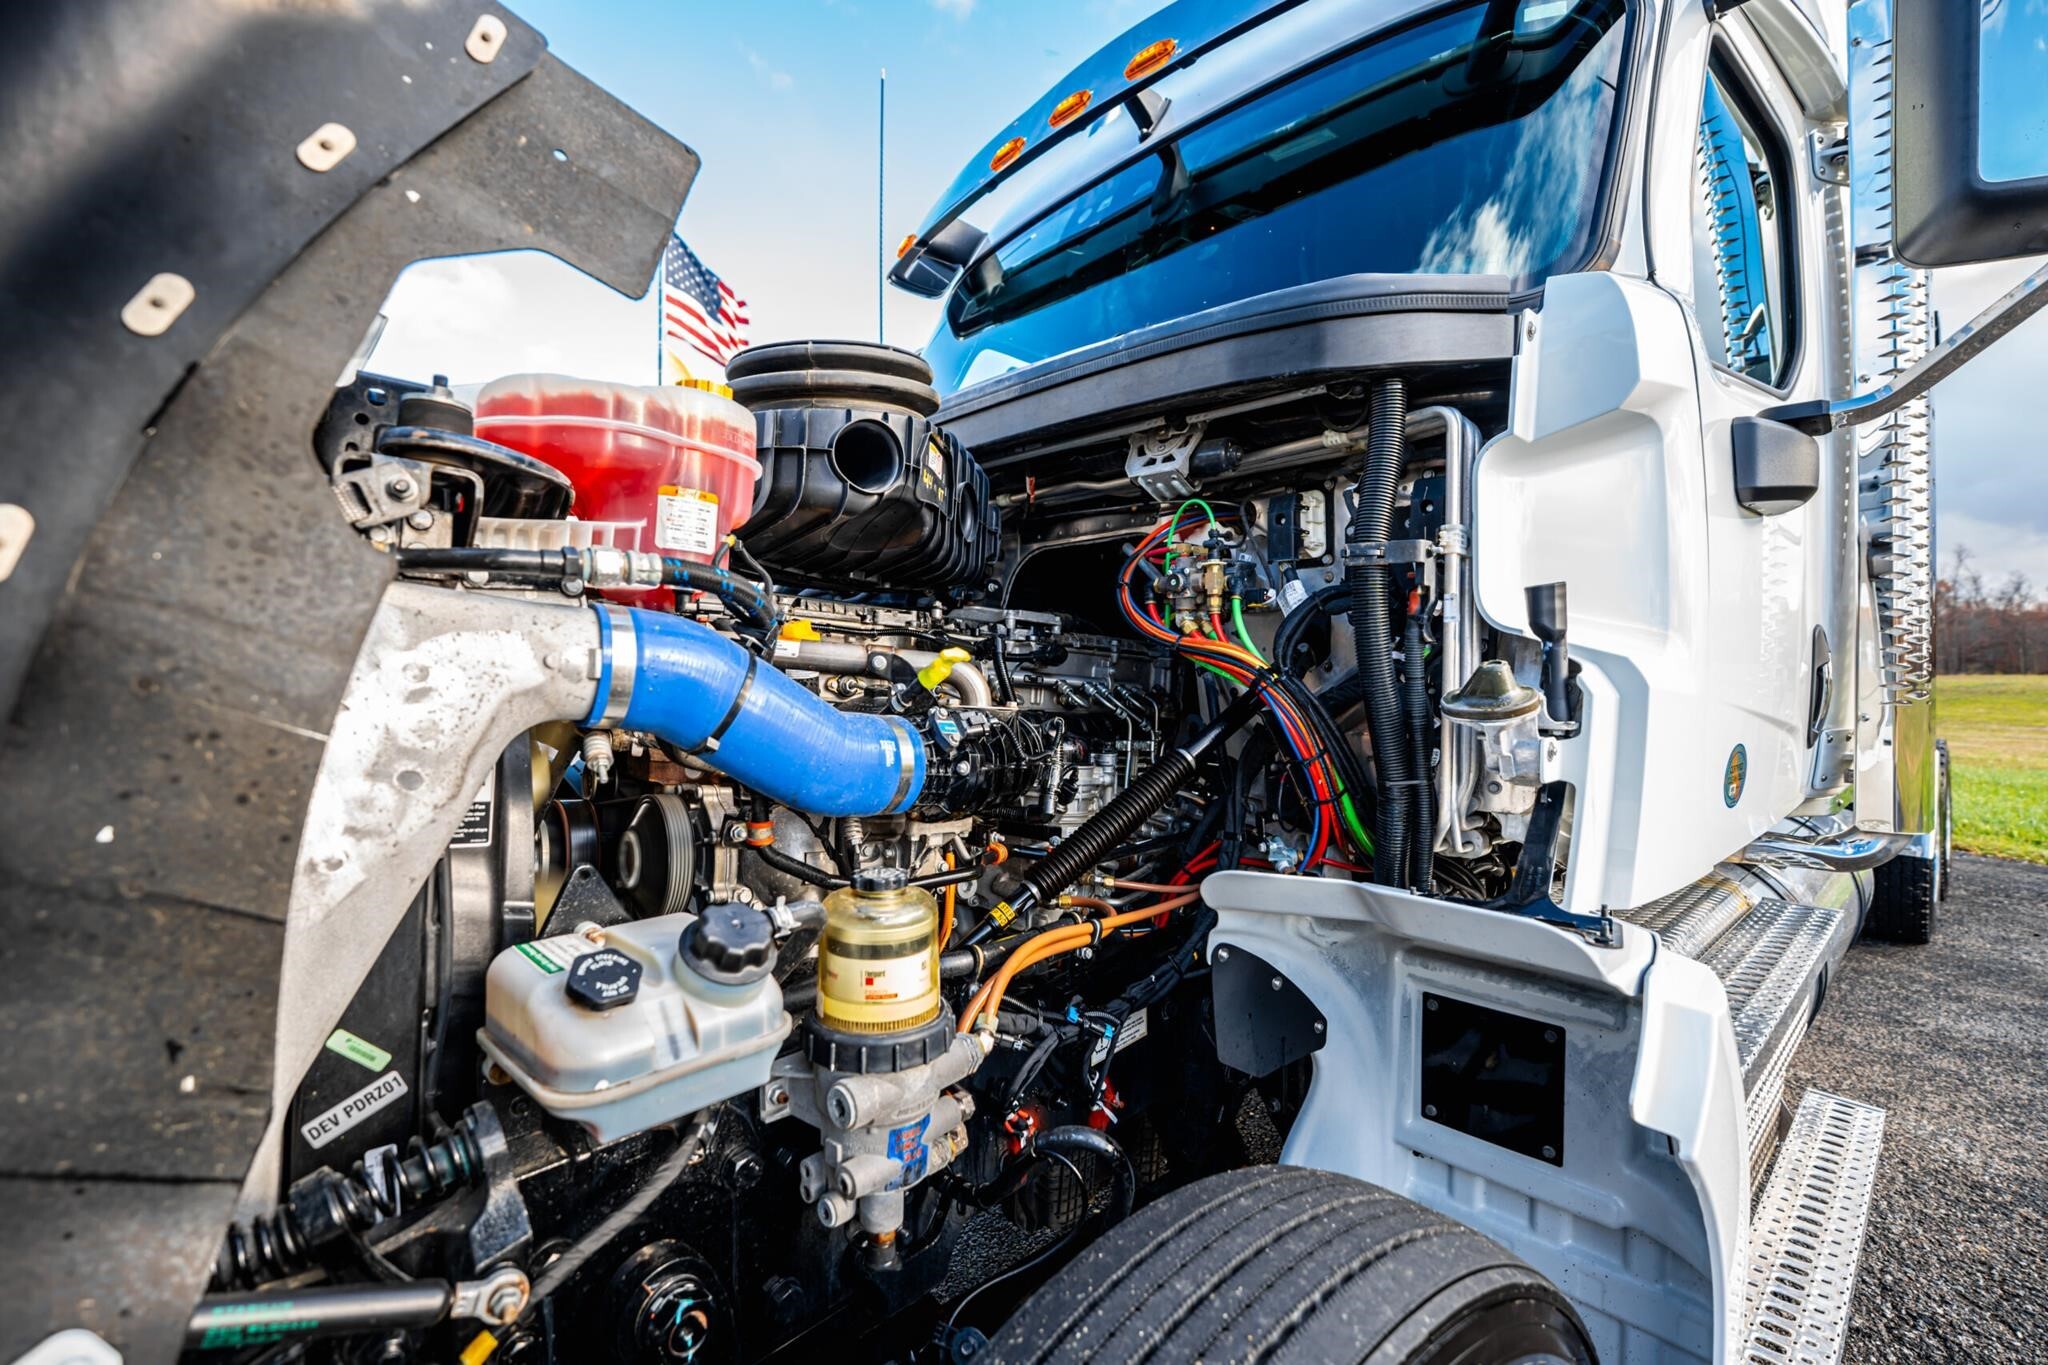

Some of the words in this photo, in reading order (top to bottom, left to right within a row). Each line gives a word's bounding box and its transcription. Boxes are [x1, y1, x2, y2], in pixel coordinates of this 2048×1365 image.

[577, 957, 594, 976] POWER
[594, 954, 629, 966] STEERING
[590, 960, 614, 970] FLUID
[307, 1113, 340, 1141] DEV
[343, 1076, 402, 1119] PDRZ01
